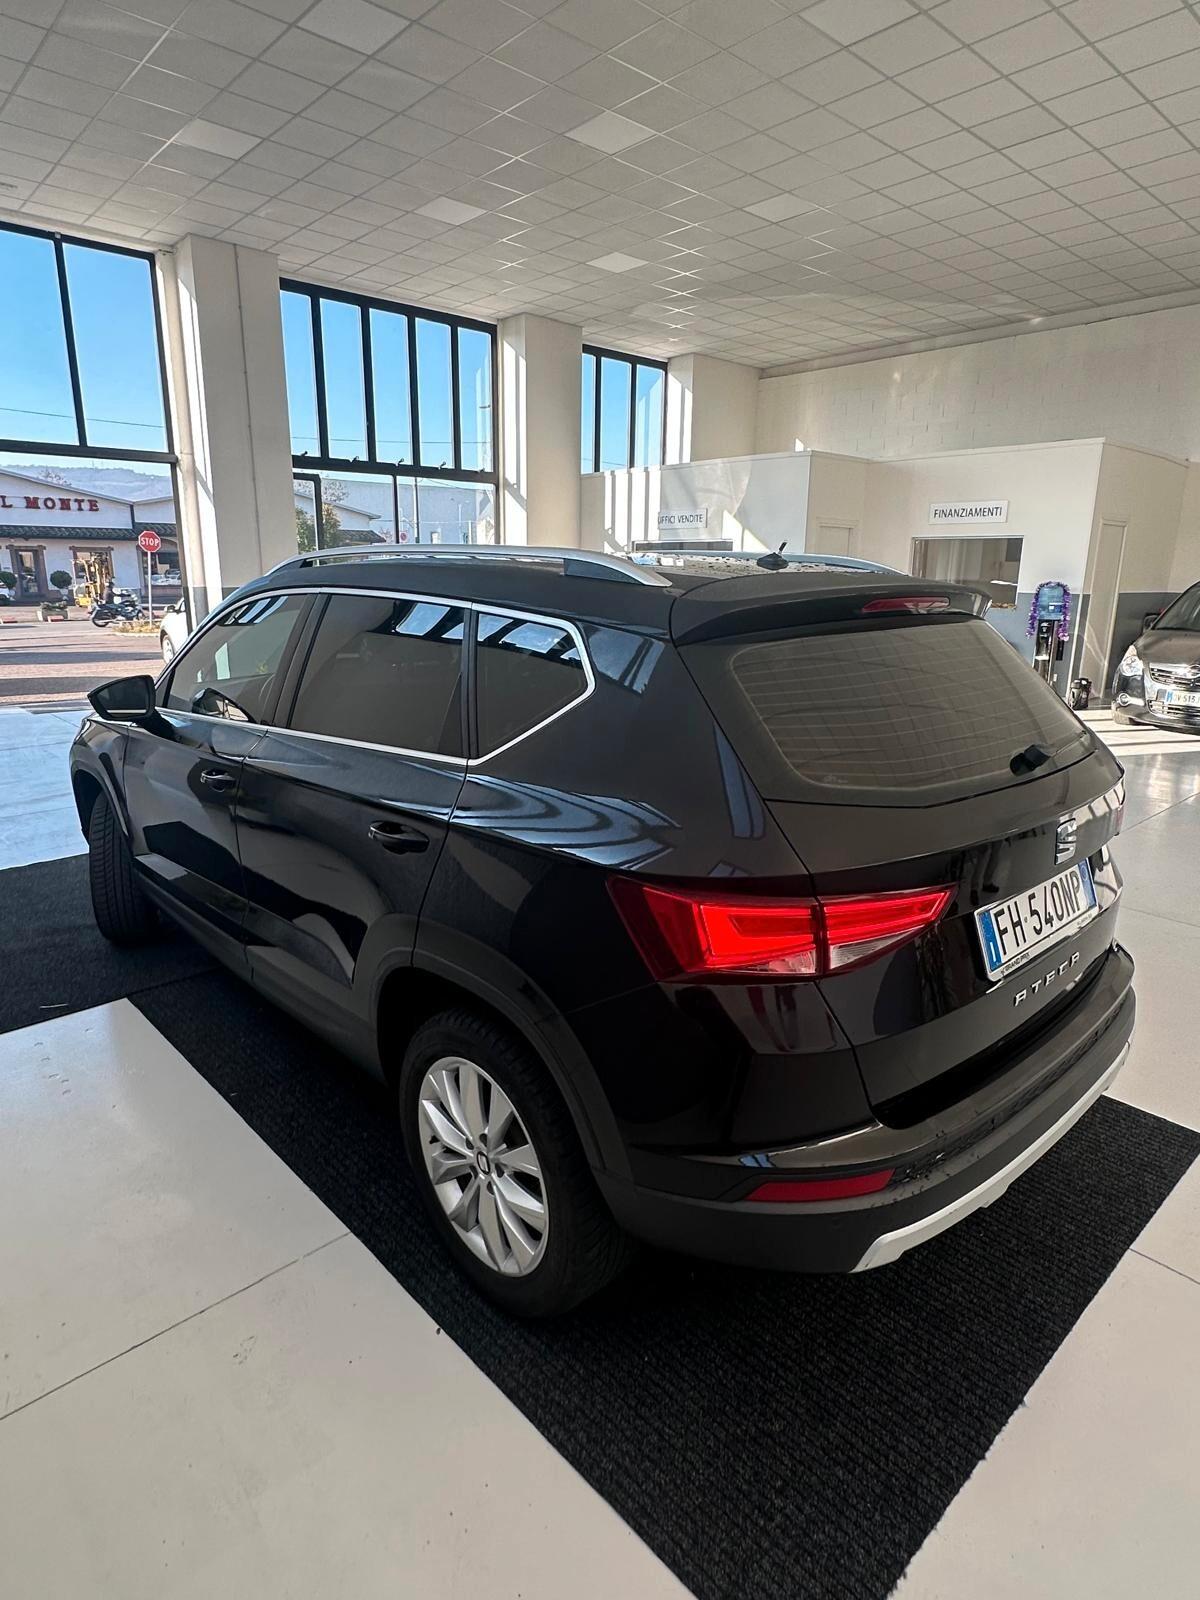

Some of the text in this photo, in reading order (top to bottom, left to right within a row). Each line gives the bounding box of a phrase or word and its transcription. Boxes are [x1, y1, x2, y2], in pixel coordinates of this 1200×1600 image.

[24, 496, 99, 511] MONTE
[934, 506, 1002, 518] FINANZIAMENTI
[678, 514, 703, 523] VENDITE
[140, 537, 160, 547] STOP
[1013, 951, 1080, 1007] ATECA
